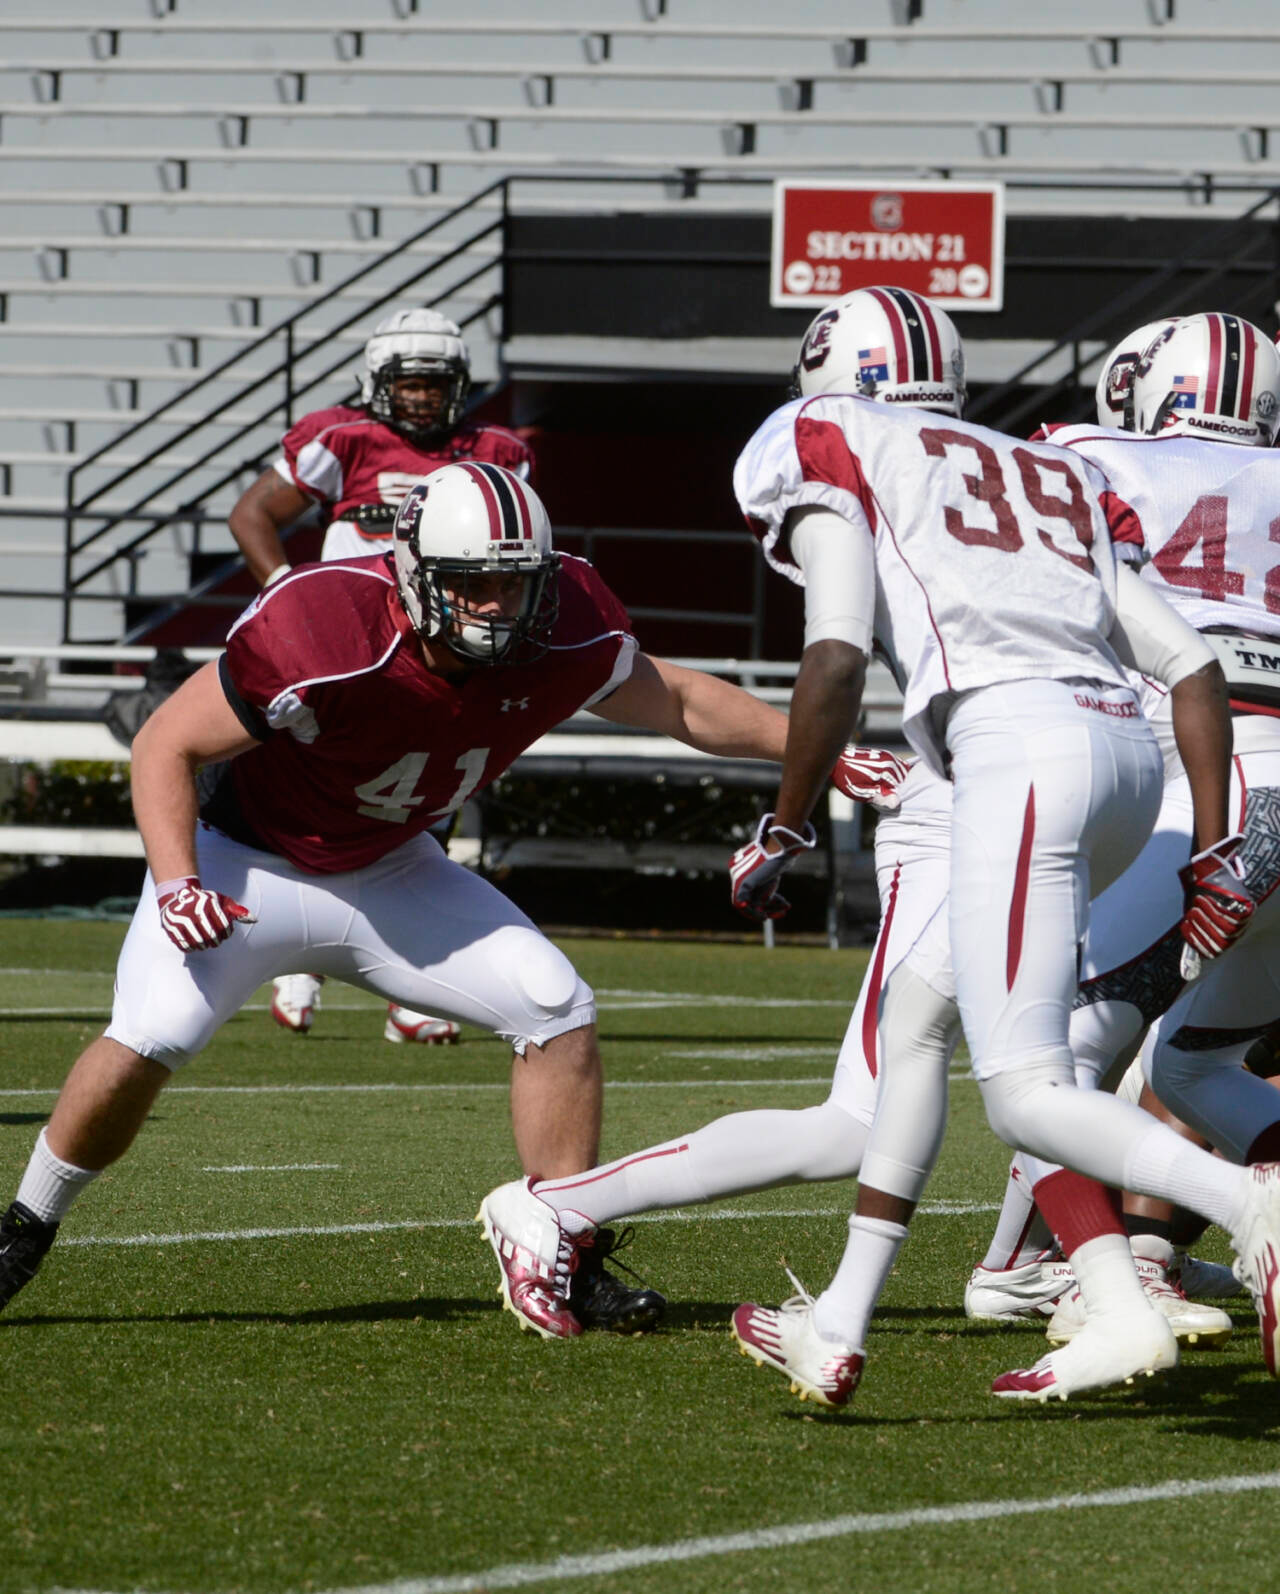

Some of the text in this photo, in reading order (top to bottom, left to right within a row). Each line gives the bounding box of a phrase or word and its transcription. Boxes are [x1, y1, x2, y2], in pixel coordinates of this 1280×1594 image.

[806, 230, 966, 262] SECTION 21
[813, 265, 842, 292] 22
[928, 268, 958, 293] 20
[884, 392, 954, 403] GAMECOCKS
[1187, 417, 1259, 436] GAMECOCKS
[918, 427, 1095, 575] 39
[354, 747, 492, 824] 41
